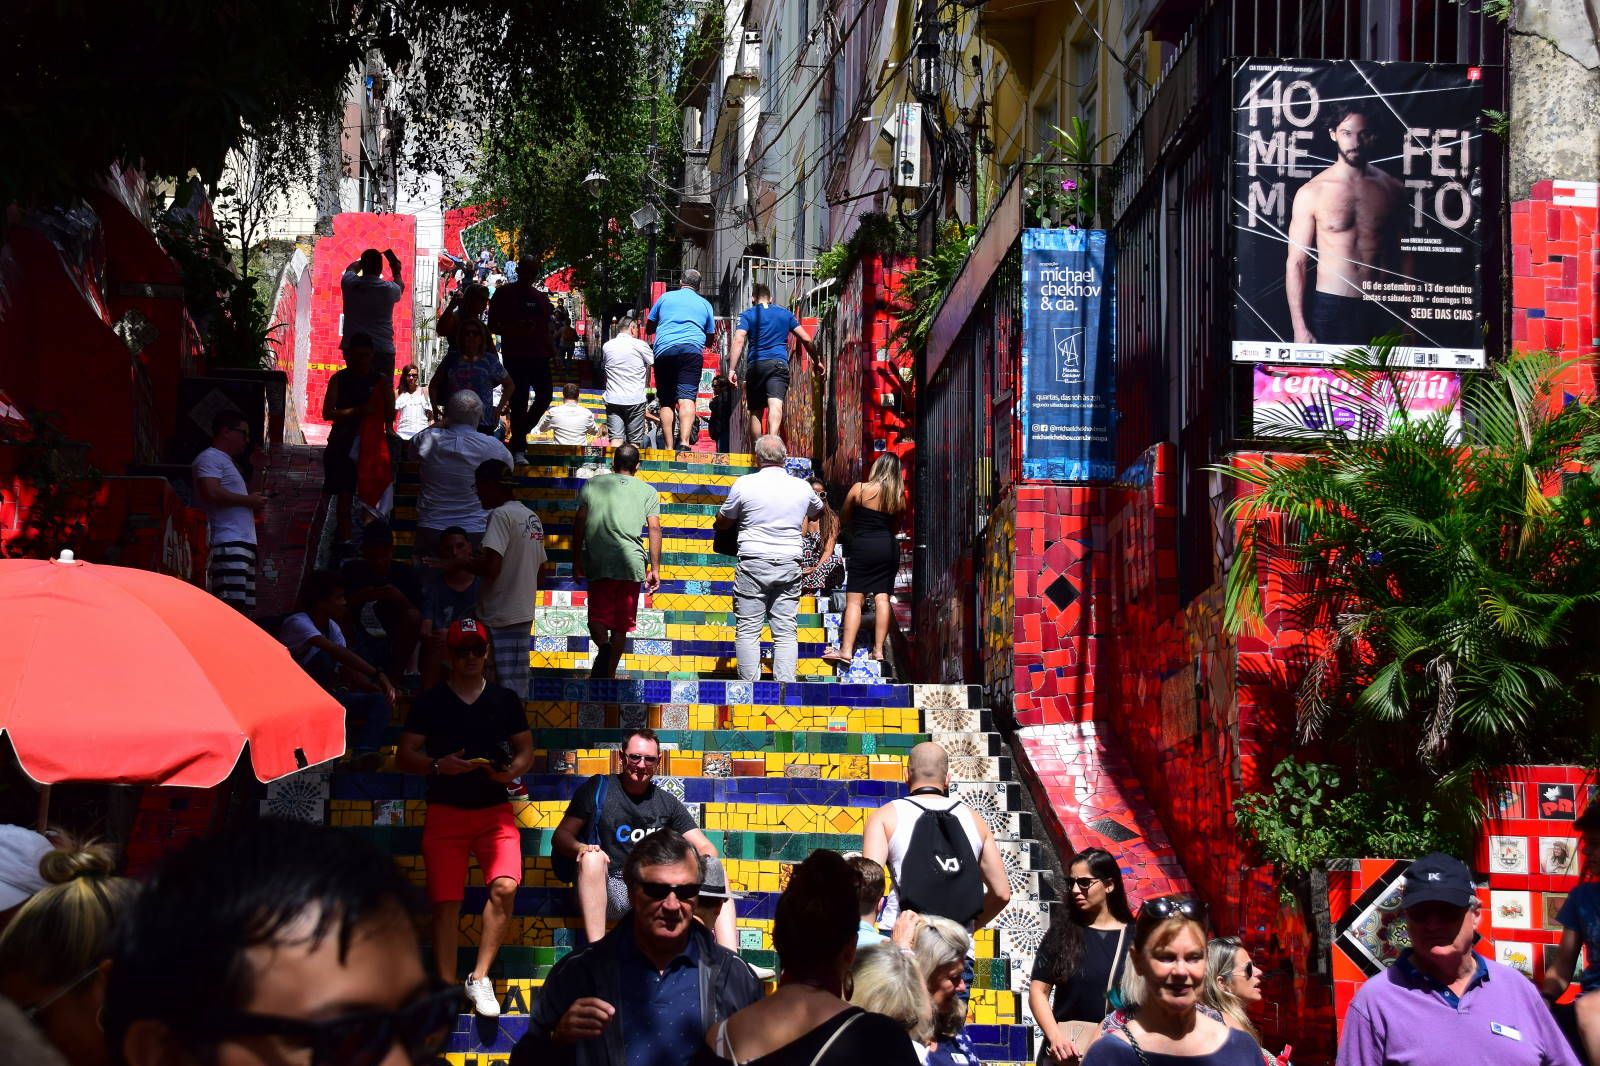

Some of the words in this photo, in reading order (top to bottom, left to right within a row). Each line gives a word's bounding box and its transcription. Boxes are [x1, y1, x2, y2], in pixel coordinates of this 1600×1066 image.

[1248, 131, 1314, 178] ME
[1403, 128, 1471, 178] FEI
[1248, 181, 1285, 227] M
[1404, 180, 1472, 229] TO
[1041, 266, 1094, 282] michael
[1041, 280, 1100, 297] chekhov
[1362, 281, 1371, 290] 06
[1373, 282, 1381, 290] de
[1383, 282, 1416, 292] setembro
[1424, 283, 1433, 292] 13
[1434, 284, 1444, 293] de
[1445, 285, 1472, 294] outubro
[1041, 296, 1053, 310] &
[1056, 297, 1078, 311] cia.
[1432, 296, 1460, 305] domingos
[1410, 308, 1432, 319] SEDE
[1435, 308, 1451, 320] DAS
[1454, 309, 1473, 320] CIAS
[1271, 374, 1364, 396] Temos
